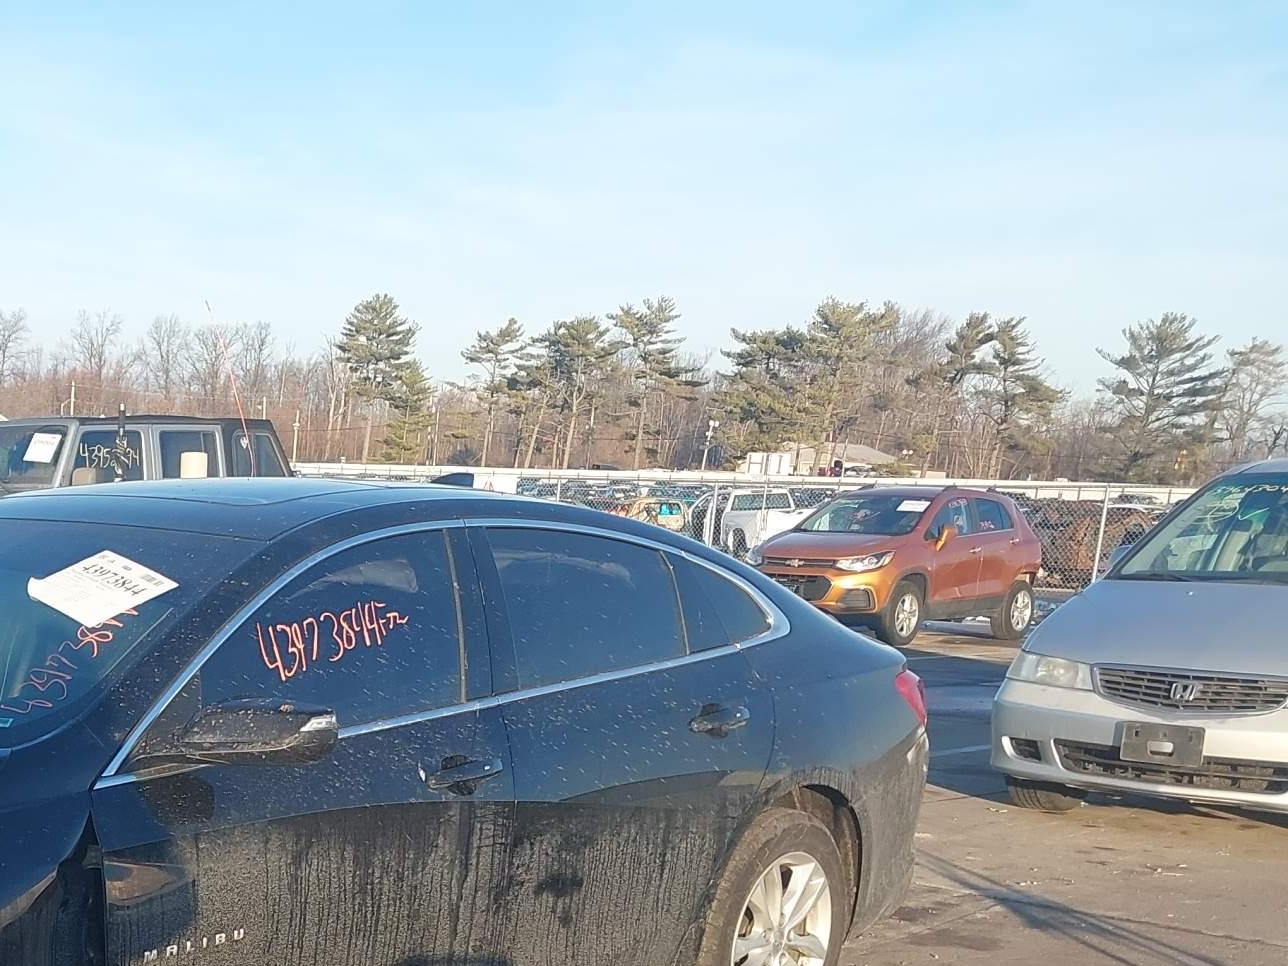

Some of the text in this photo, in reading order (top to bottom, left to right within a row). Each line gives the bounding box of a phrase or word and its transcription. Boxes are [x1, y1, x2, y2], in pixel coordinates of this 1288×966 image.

[80, 442, 139, 470] 4395294
[82, 563, 148, 597] 43973844
[143, 928, 244, 962] MALIBU
